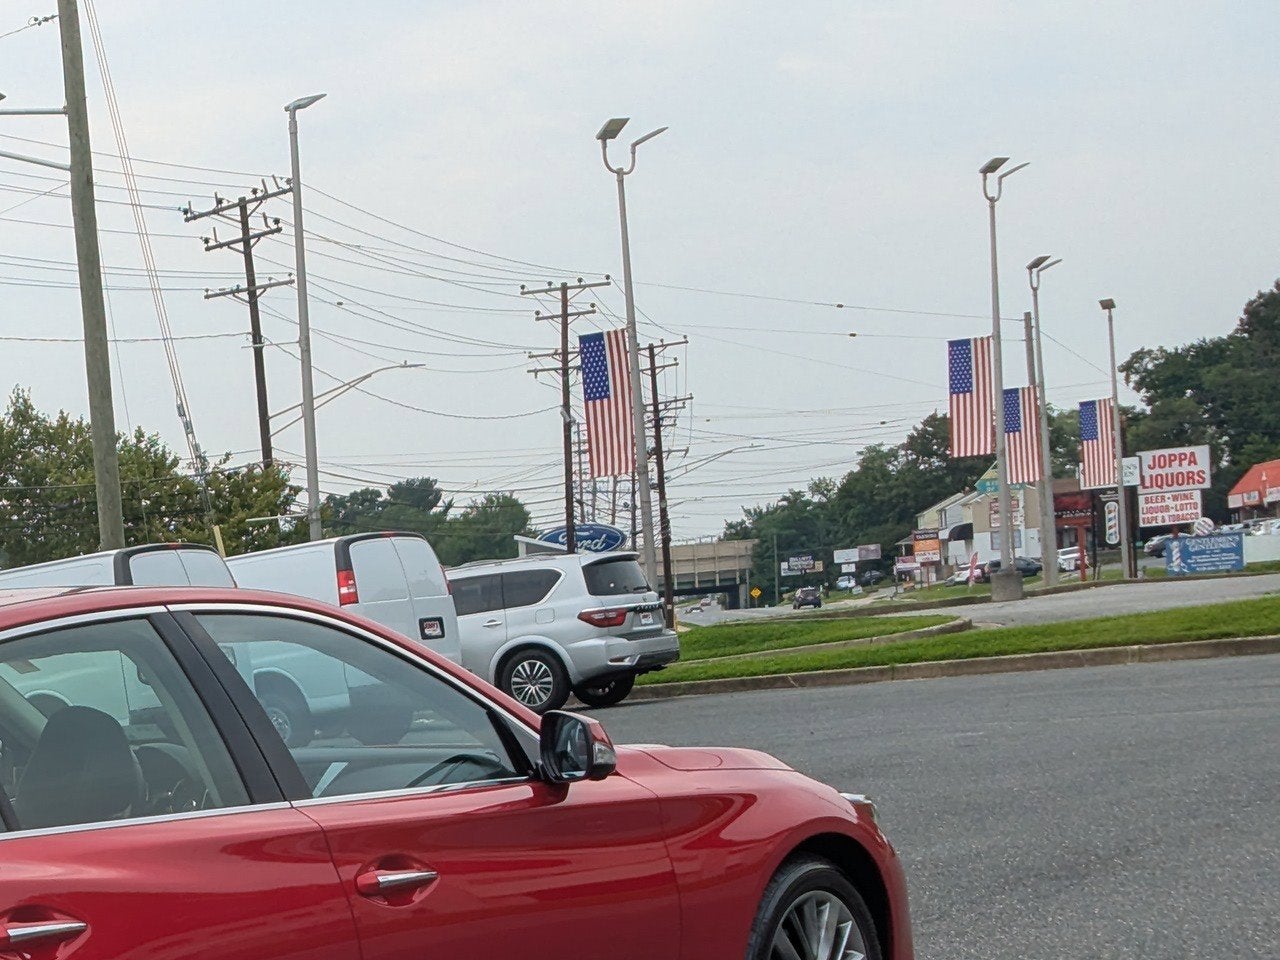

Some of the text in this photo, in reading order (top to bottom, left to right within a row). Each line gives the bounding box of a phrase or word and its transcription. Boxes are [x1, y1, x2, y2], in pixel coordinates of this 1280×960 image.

[1147, 451, 1198, 470] JOPPA
[1140, 469, 1206, 490] LIQUORS
[558, 530, 607, 551] Frd
